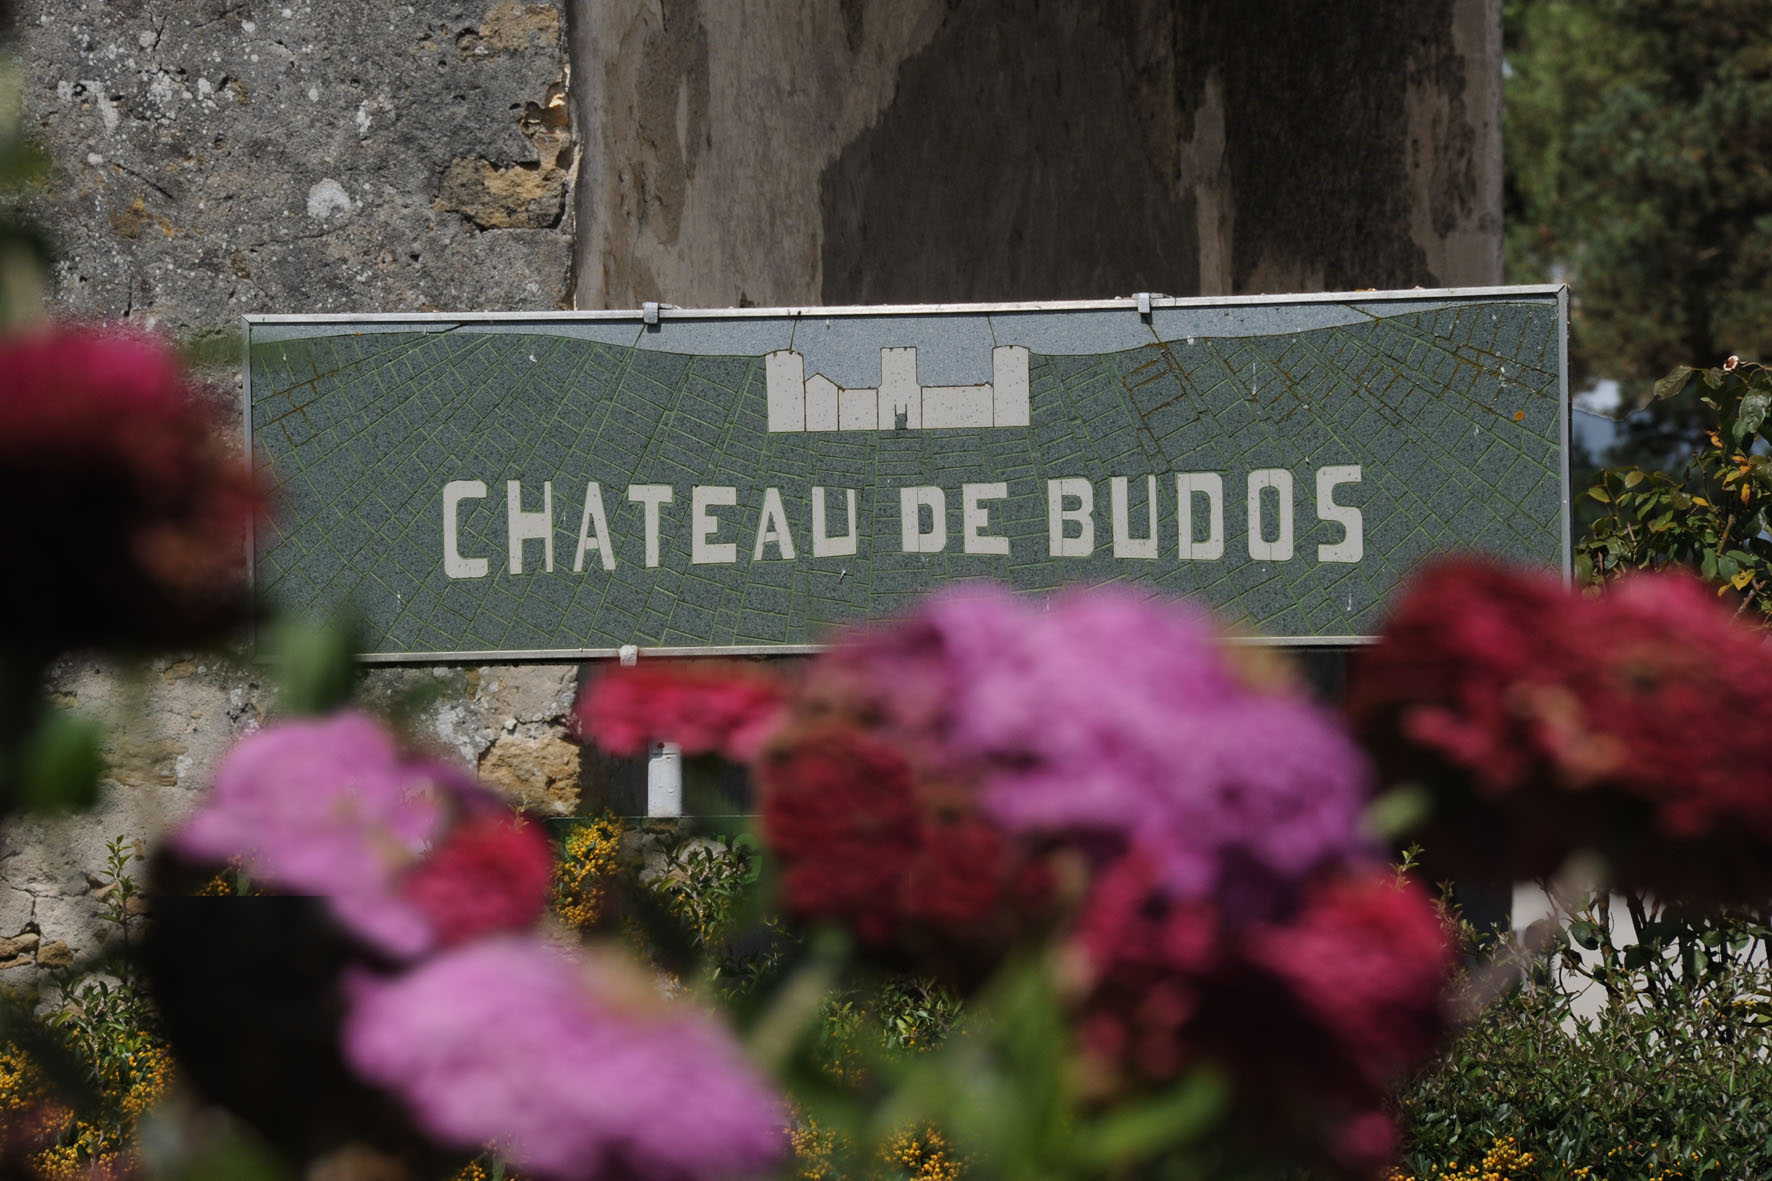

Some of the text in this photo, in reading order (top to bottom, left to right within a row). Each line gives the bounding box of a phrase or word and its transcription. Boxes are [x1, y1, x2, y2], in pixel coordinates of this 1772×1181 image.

[442, 464, 1364, 579] CHATEAU DE BUDOS
